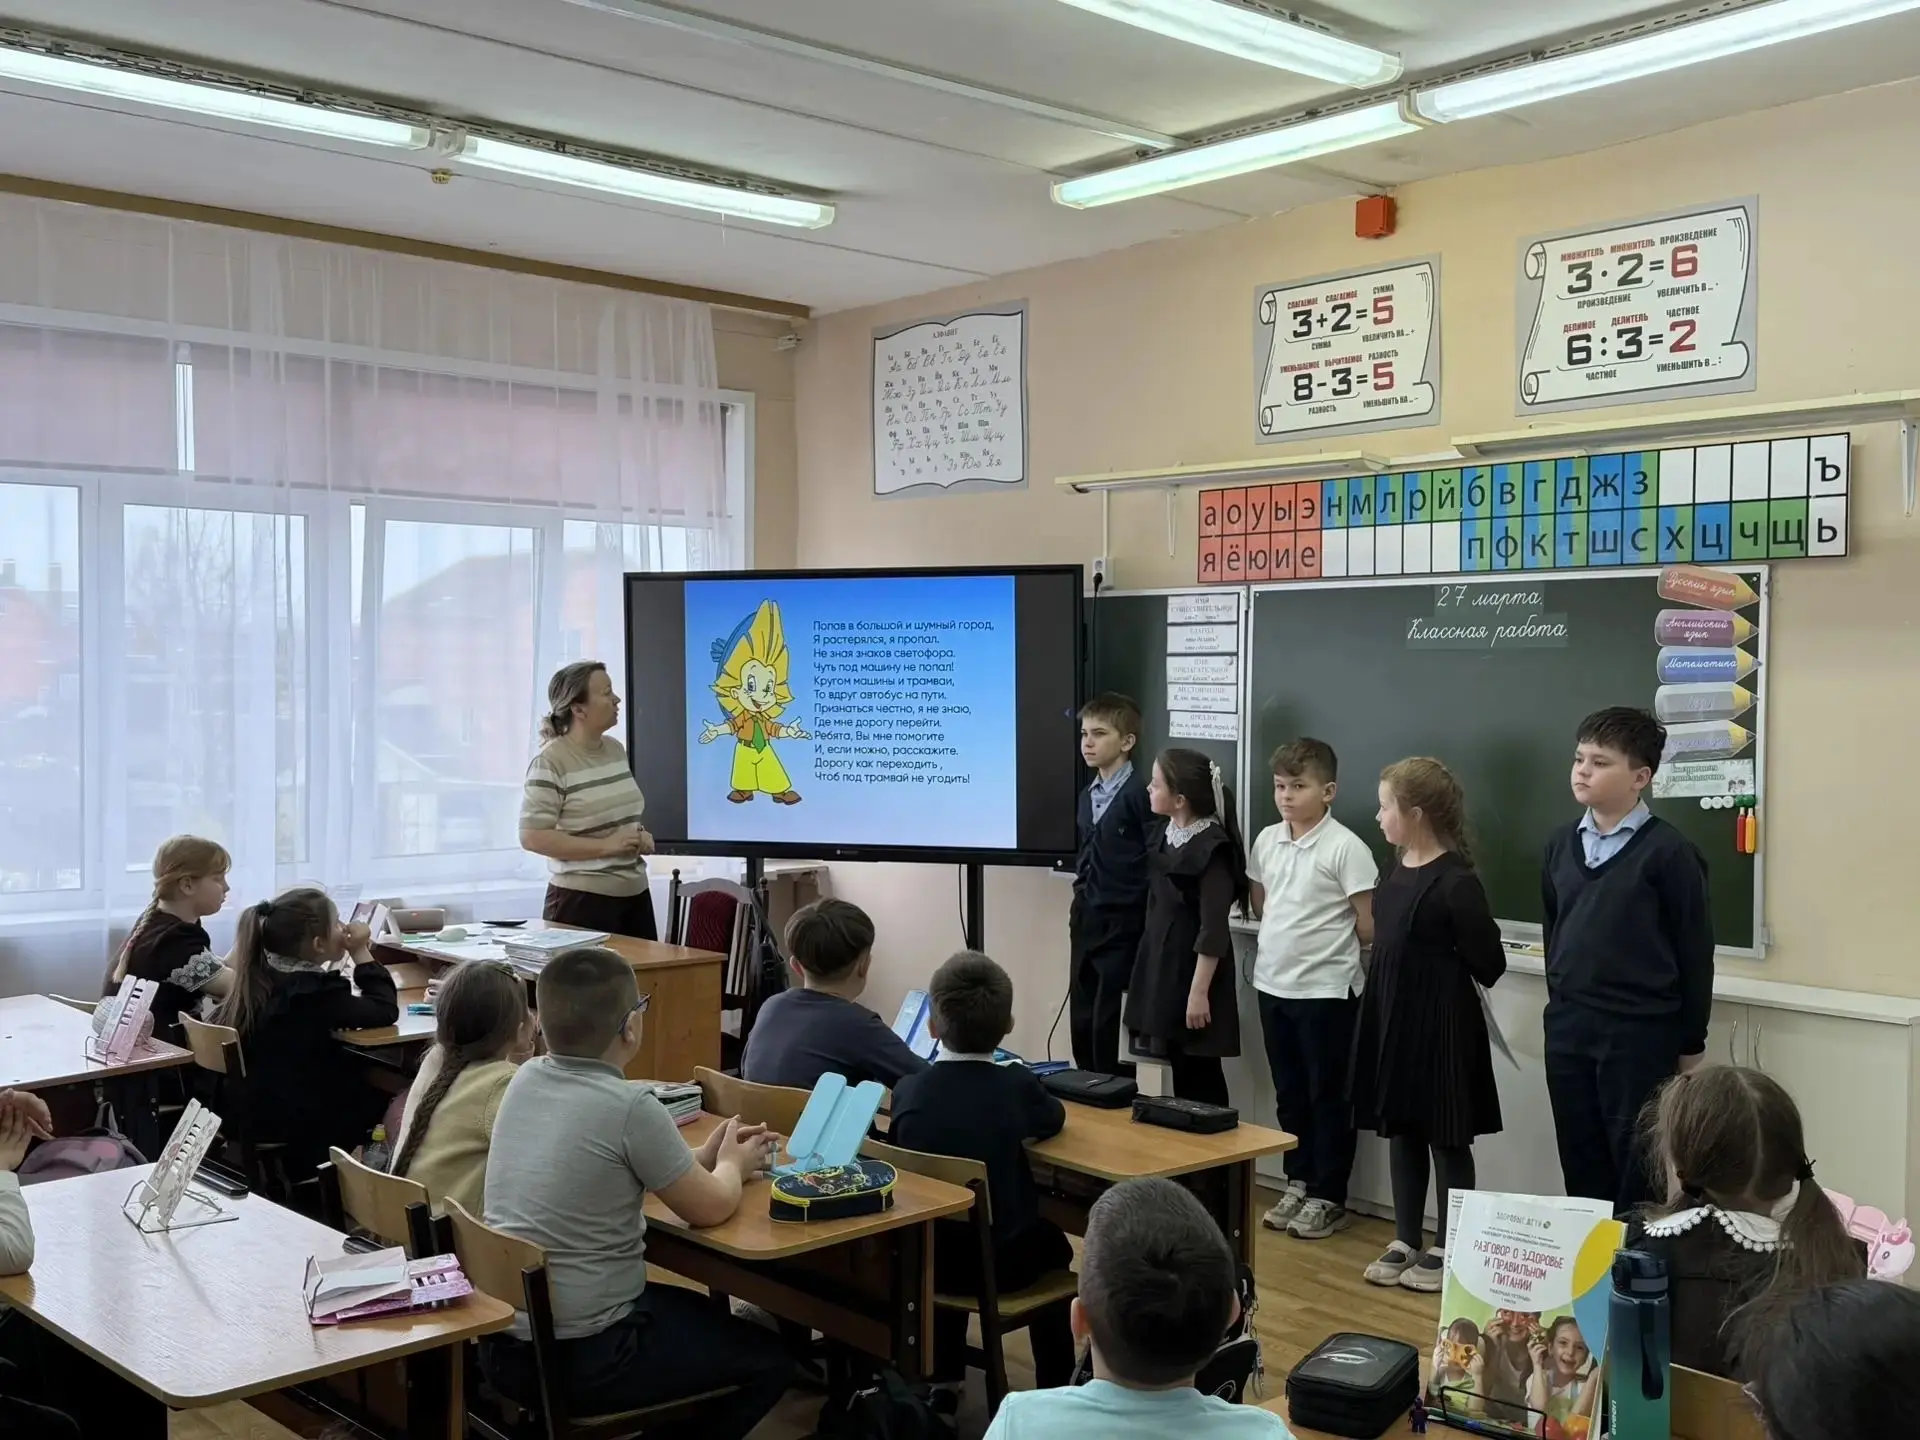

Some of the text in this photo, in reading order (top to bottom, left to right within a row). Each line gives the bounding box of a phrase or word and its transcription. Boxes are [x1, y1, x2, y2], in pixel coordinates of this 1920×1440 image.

[1610, 239, 1655, 253] МНОЖИТЕЛЬ
[1660, 228, 1717, 245] ПРОИЗВЕДЕНИЕ
[1288, 297, 1318, 309] СЛАГАЕМОЕ
[1373, 284, 1394, 294] СУММА
[1657, 283, 1700, 298] УВЕЛИЧИТЬ
[1577, 293, 1631, 309] ПРОИЗВЕДЕНИЕ
[1563, 306, 1699, 333] ДЕЛИМОЕ ДЕЛИТЕЛЬ ЧАСТНОЕ
[1362, 330, 1396, 342] УВЕЛИЧИТЬ
[1312, 341, 1331, 350] СУММА
[1369, 350, 1398, 360] РАЗНОСТЬ
[1657, 359, 1702, 372] УМЕНЬШИТЬ
[1586, 370, 1616, 381] ЧАСТНОЕ
[1363, 397, 1398, 408] УМЕНЬШИТЬ
[1308, 405, 1336, 414] РАЗНОСТЬ
[1666, 571, 1736, 597] Русский язык
[1438, 585, 1467, 607] 27
[814, 621, 845, 630] Попав
[857, 621, 902, 630] большой
[915, 620, 956, 632] шумный
[959, 622, 994, 631] город,
[1407, 618, 1488, 639] Классная
[1666, 617, 1728, 629] Английский
[813, 635, 820, 644] Я
[823, 637, 886, 647] растерялся,
[898, 636, 939, 645] пропал.
[1684, 630, 1708, 642] язык
[814, 648, 827, 658] Не
[856, 650, 891, 658] знаков
[894, 648, 955, 659] светофора.
[814, 662, 836, 673] Чуть
[839, 664, 858, 672] под
[861, 664, 901, 674] машину
[919, 662, 954, 672] попал!
[814, 676, 851, 687] Кругом
[907, 678, 954, 687] трамваи,
[814, 690, 826, 699] То
[828, 692, 857, 701] вдруг
[860, 690, 902, 701] автобус
[921, 692, 946, 702] пути.
[814, 703, 873, 715] Признаться
[876, 705, 914, 715] честно,
[942, 706, 971, 715] знаю,
[814, 717, 831, 727] Где
[855, 719, 893, 729] дорогу
[896, 718, 942, 729] перейти.
[815, 730, 853, 742] Ребята,
[856, 731, 870, 740] Вы
[895, 733, 944, 741] помогите
[815, 744, 824, 755] И,
[854, 747, 890, 755] можно,
[893, 745, 958, 756] расскажите.
[814, 758, 937, 770] Дорогу как переходить
[815, 772, 840, 781] Чтоб
[843, 774, 862, 783] под
[864, 773, 909, 784] трамвай
[927, 774, 970, 785] угодить!
[1473, 1240, 1564, 1269] РАЗГОВОР О ЗДОРОВЬЕ
[1484, 1256, 1546, 1280] И ПРАВИЛЬНОМ
[1492, 1273, 1532, 1292] ПИТАНИИ
